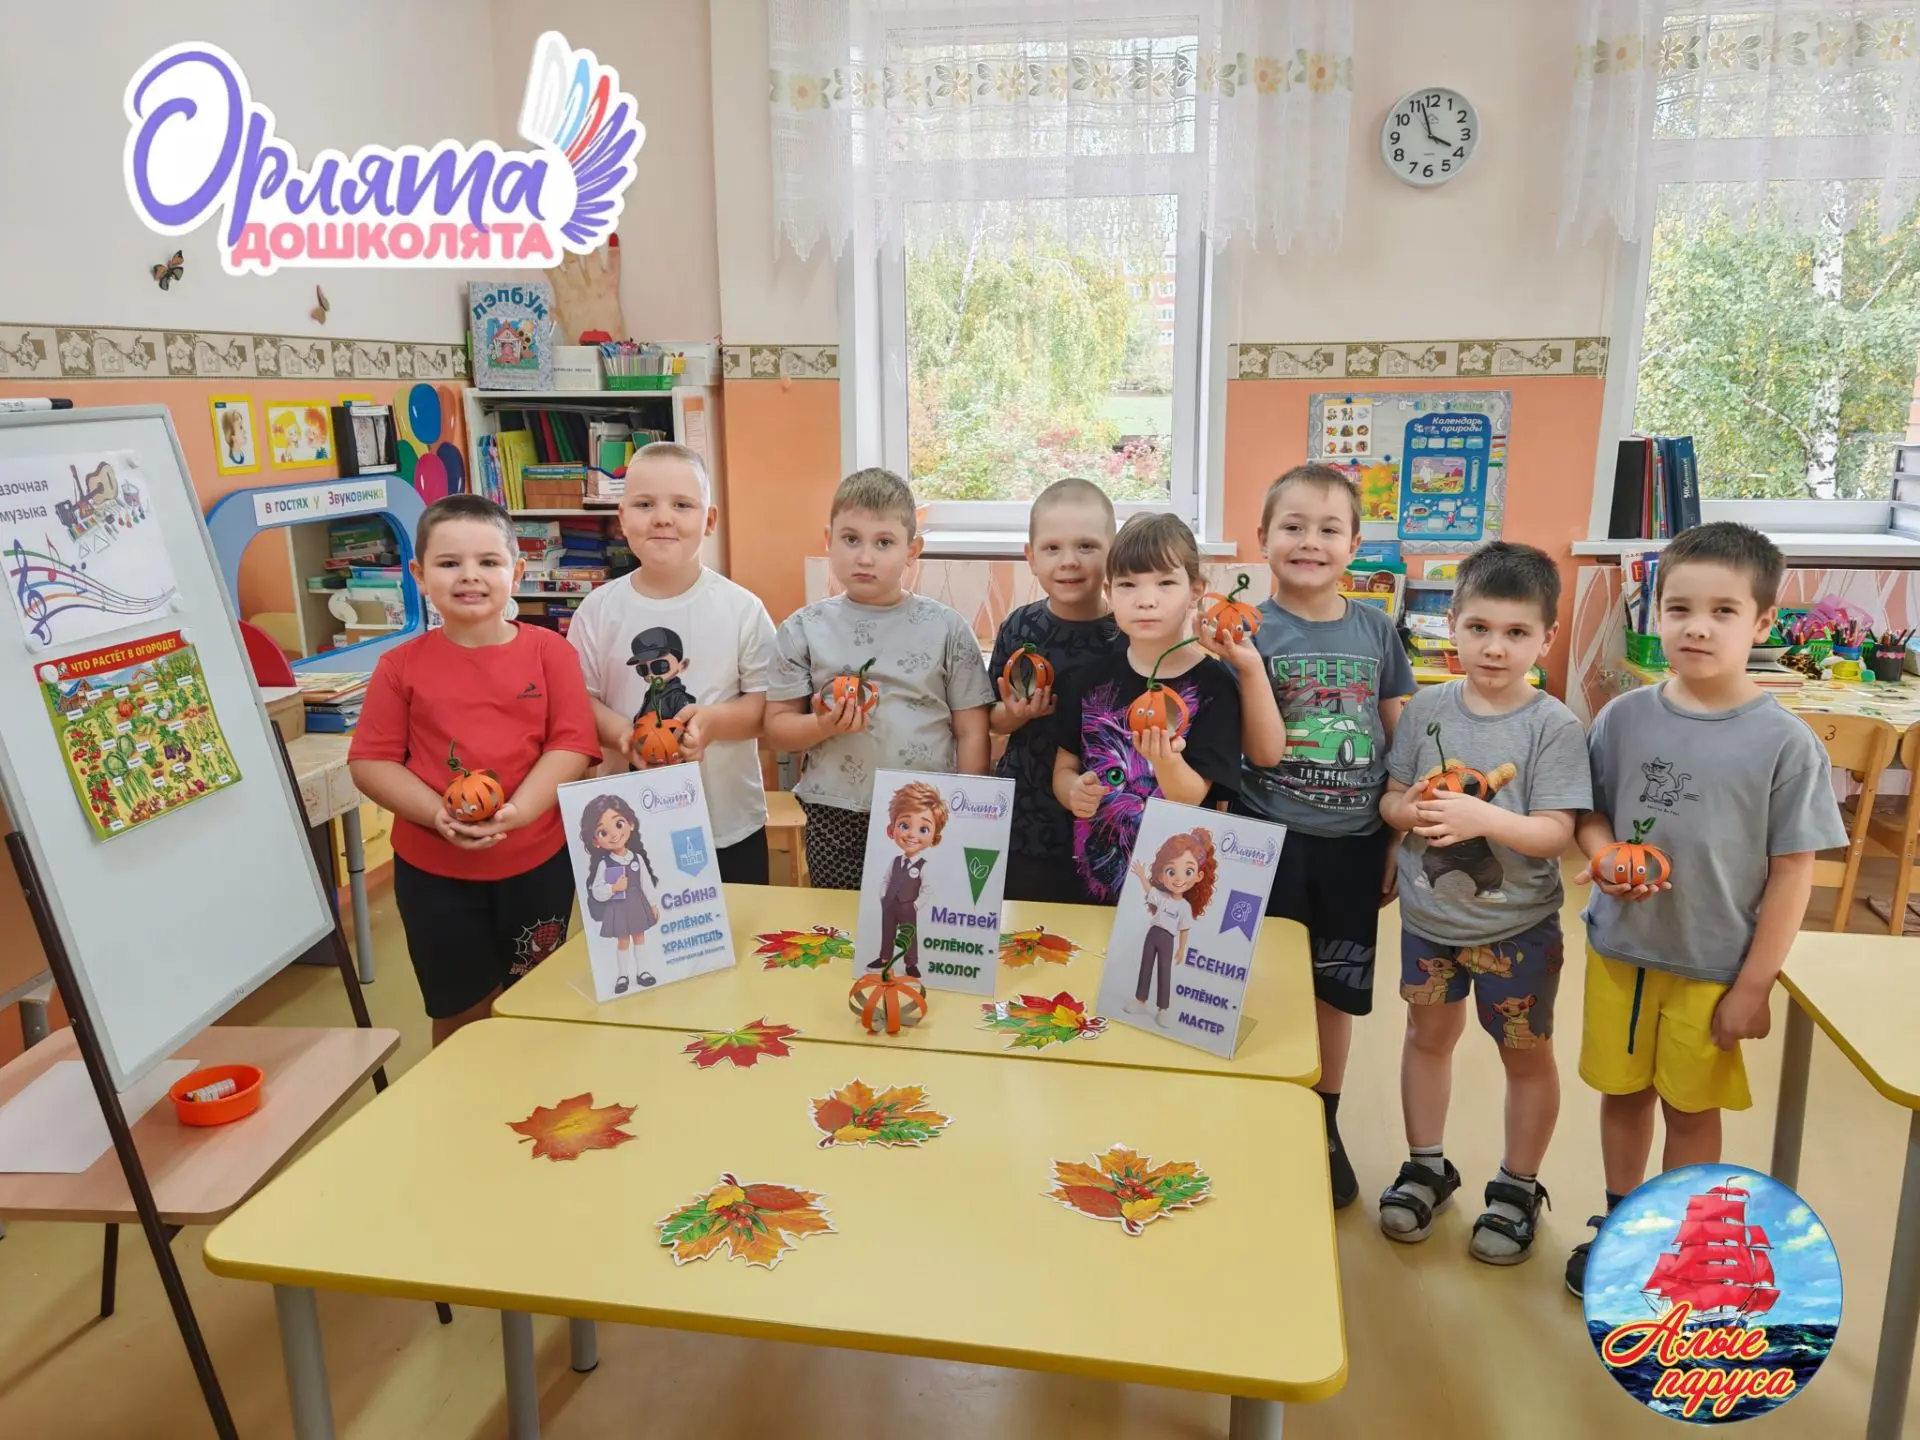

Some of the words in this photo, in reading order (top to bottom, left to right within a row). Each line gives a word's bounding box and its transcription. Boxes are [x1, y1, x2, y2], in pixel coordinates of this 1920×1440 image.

[1409, 100, 1421, 113] 11
[1425, 94, 1440, 108] 12
[1447, 98, 1453, 111] 1
[1395, 113, 1410, 127] 10
[1456, 110, 1467, 123] 2
[1390, 131, 1400, 145] 9
[1460, 128, 1471, 141] 3
[1393, 148, 1404, 162] 8
[1452, 146, 1464, 158] 4
[1409, 161, 1419, 174] 7
[1422, 164, 1434, 178] 6
[1441, 159, 1451, 172] 5
[472, 287, 548, 320] лэпбук
[1432, 416, 1483, 427] Календарь
[1441, 425, 1483, 434] природы
[275, 496, 309, 513] гостях
[312, 495, 320, 509] у
[328, 487, 385, 507] Звуковичка
[0, 505, 47, 524] музыка
[71, 660, 91, 673] ЧТО
[92, 651, 126, 669] РАСТЁТ
[127, 648, 134, 659] В
[135, 638, 177, 657] ОГОРОДЕ?
[1277, 659, 1377, 690] STREET
[1825, 724, 1837, 741] 3
[660, 885, 717, 910] Сабина
[660, 912, 713, 935] ОРЛЁНОК
[931, 906, 997, 930] Матвей
[662, 929, 724, 954] ХРАНИТЕЛЬ
[923, 936, 984, 956] ОРЛЁНОК
[928, 961, 981, 979] ЭКОЛОГ
[1176, 984, 1229, 1010] ОРЛЁНОК
[1178, 1012, 1225, 1035] МАСТЕР
